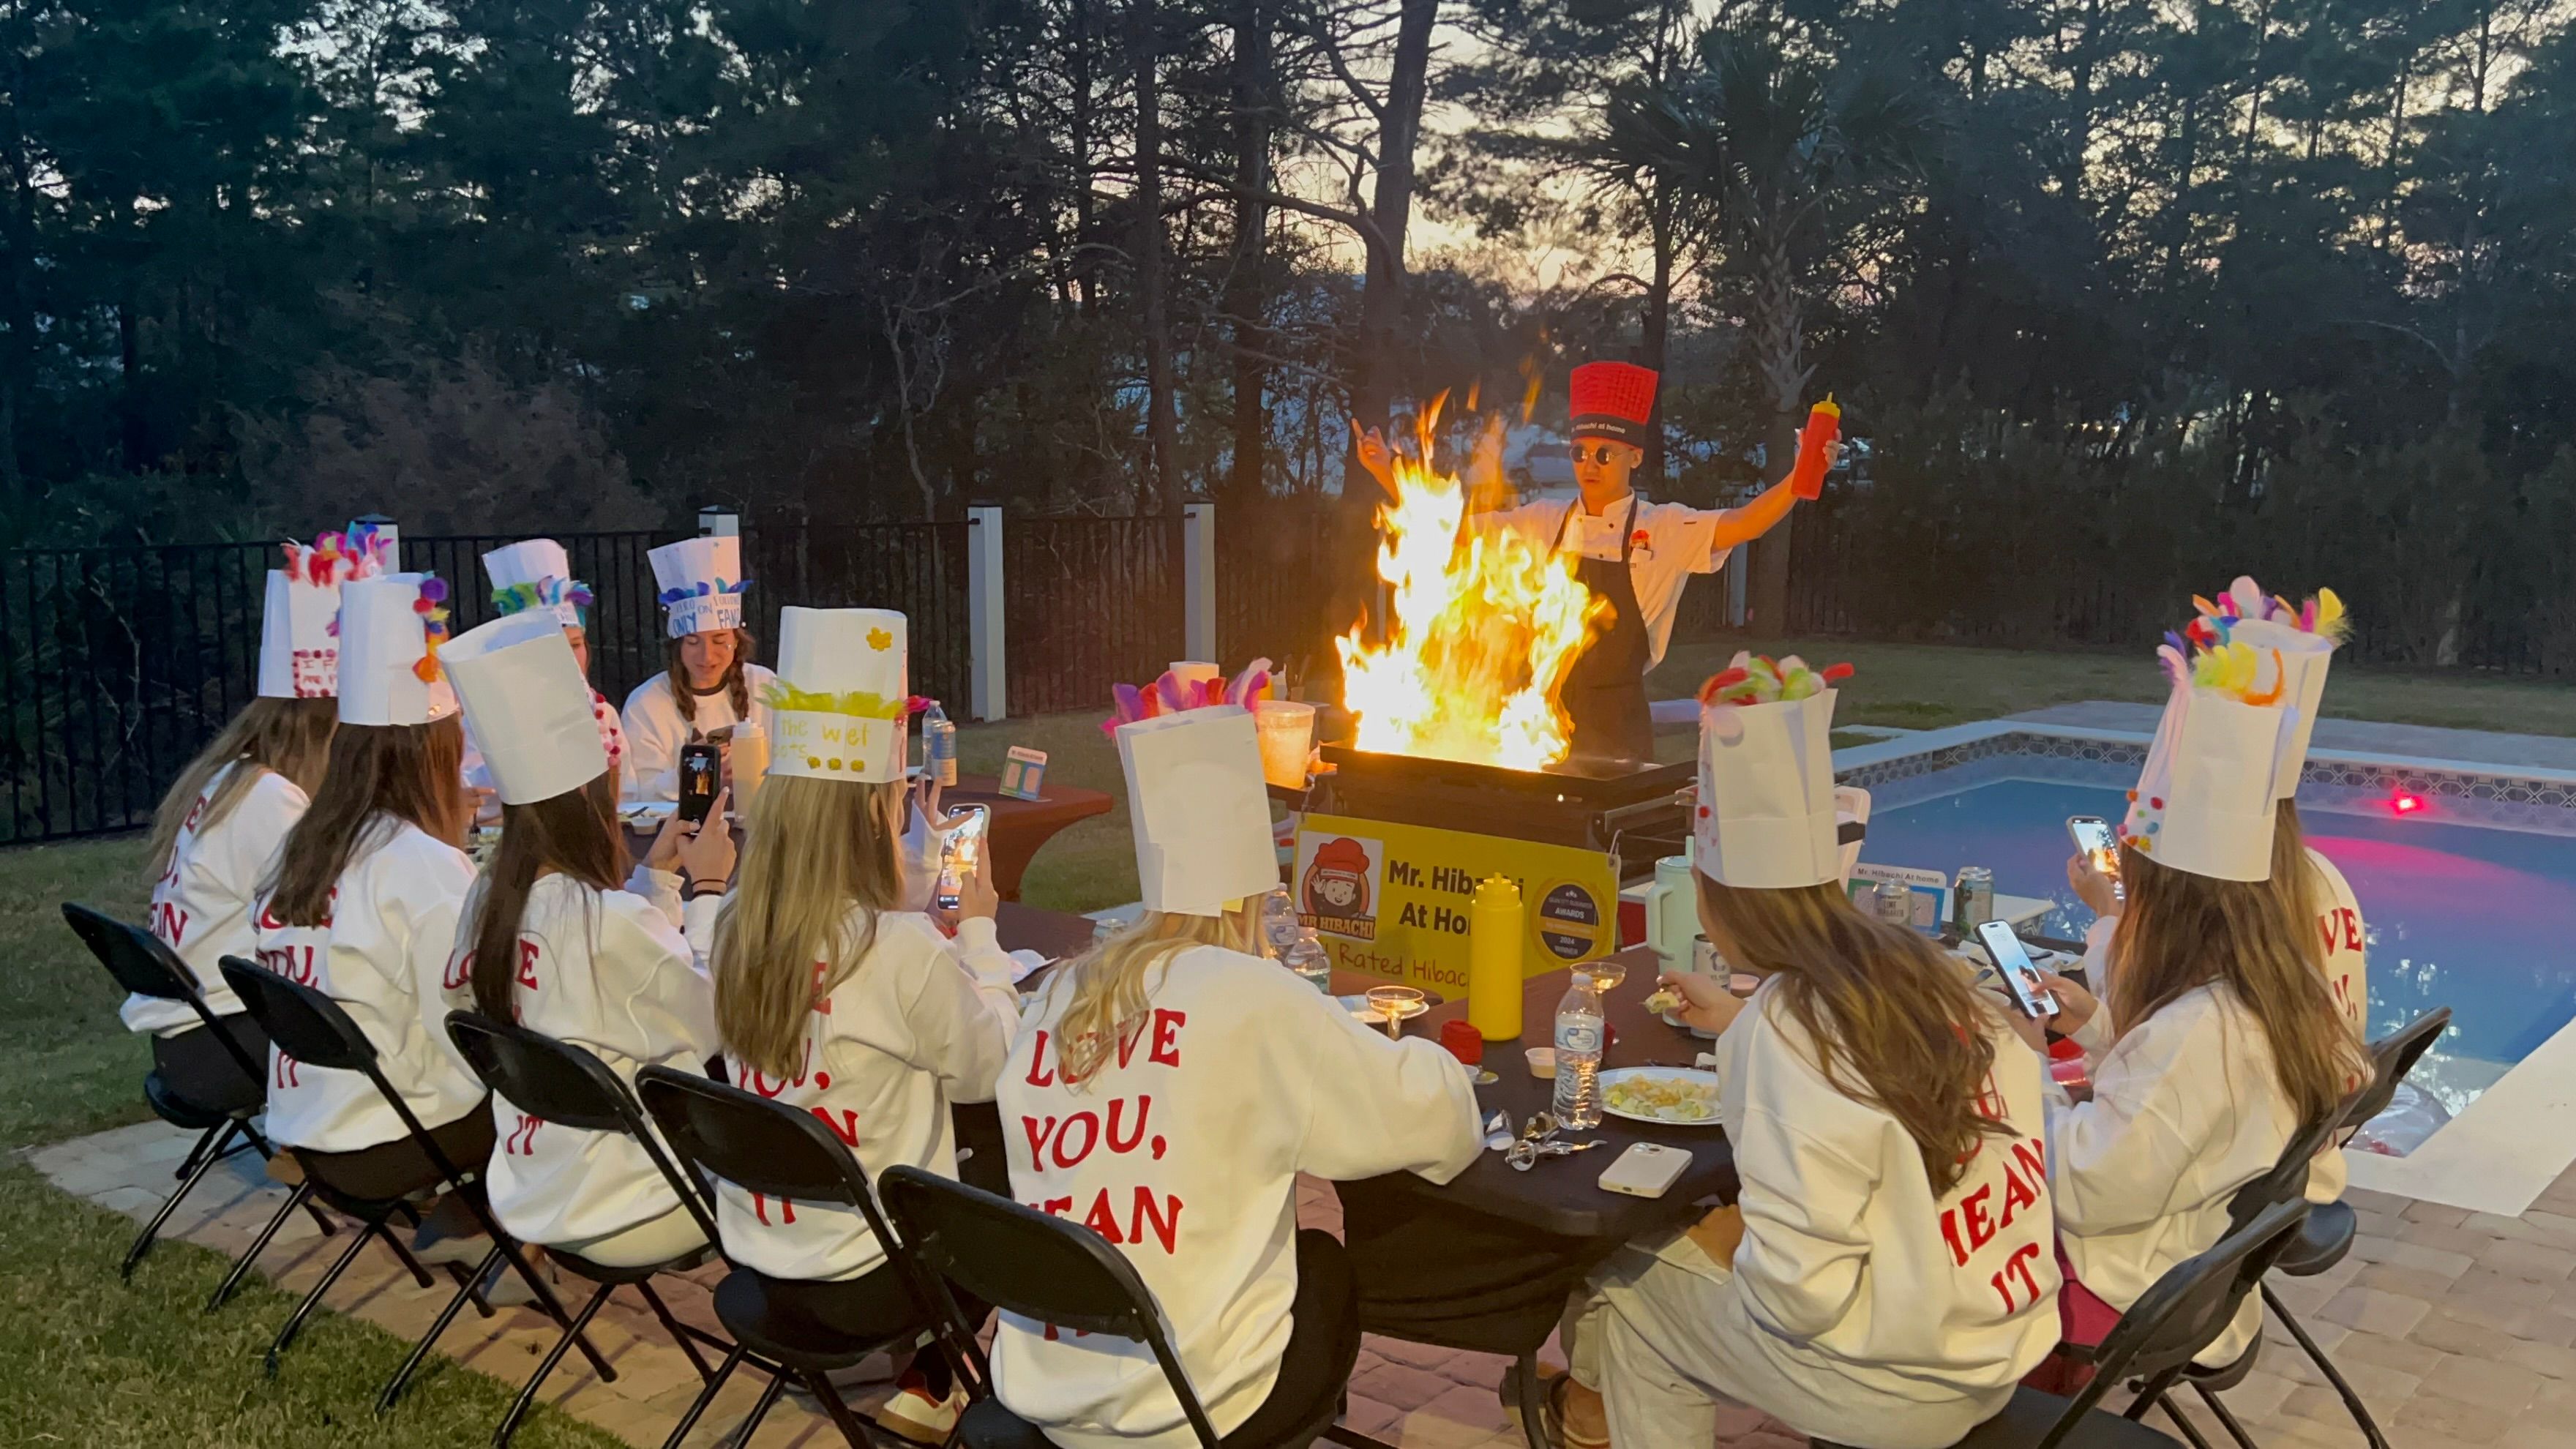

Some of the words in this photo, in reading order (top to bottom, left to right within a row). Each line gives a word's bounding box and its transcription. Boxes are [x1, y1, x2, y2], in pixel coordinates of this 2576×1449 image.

[1388, 859, 1425, 888] Mr.
[1871, 869, 1903, 879] Hibachi
[1916, 874, 1939, 884] home
[1319, 916, 1374, 939] HIBACHI
[1399, 901, 1429, 929] At
[1433, 906, 1471, 936] Ho
[1554, 907, 1585, 920] AWARDS
[2317, 906, 2363, 957] VE
[1338, 943, 1404, 976] Rated
[1413, 959, 1470, 988] Hibac
[1025, 1008, 1186, 1088] LOVE
[1022, 1095, 1167, 1172] YOU,
[1991, 1242, 2042, 1316] IT
